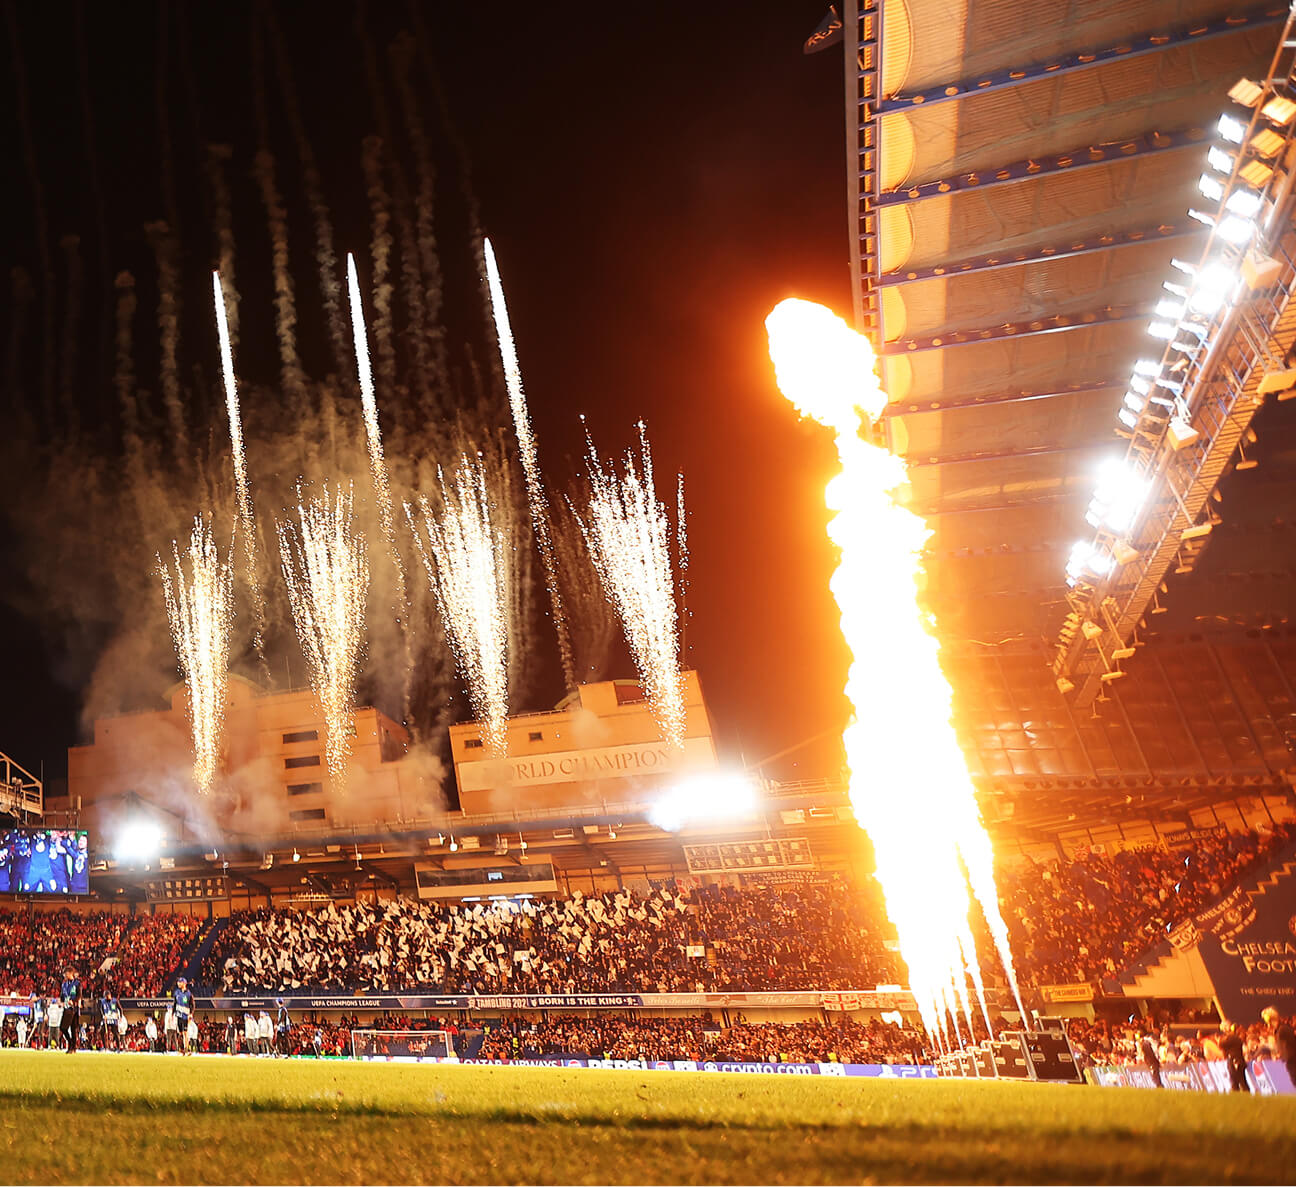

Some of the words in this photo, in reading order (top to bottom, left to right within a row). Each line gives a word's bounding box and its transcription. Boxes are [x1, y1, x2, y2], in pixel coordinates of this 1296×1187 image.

[1195, 896, 1235, 922] CHELSEA
[1221, 939, 1296, 956] CHELSEA
[477, 998, 512, 1008] TAMBLING
[538, 997, 563, 1006] BORN
[566, 997, 576, 1006] IS
[577, 997, 597, 1005] THE
[598, 996, 623, 1005] KING
[508, 1059, 558, 1067] AIRWAYS
[588, 1060, 648, 1070] PEPSI
